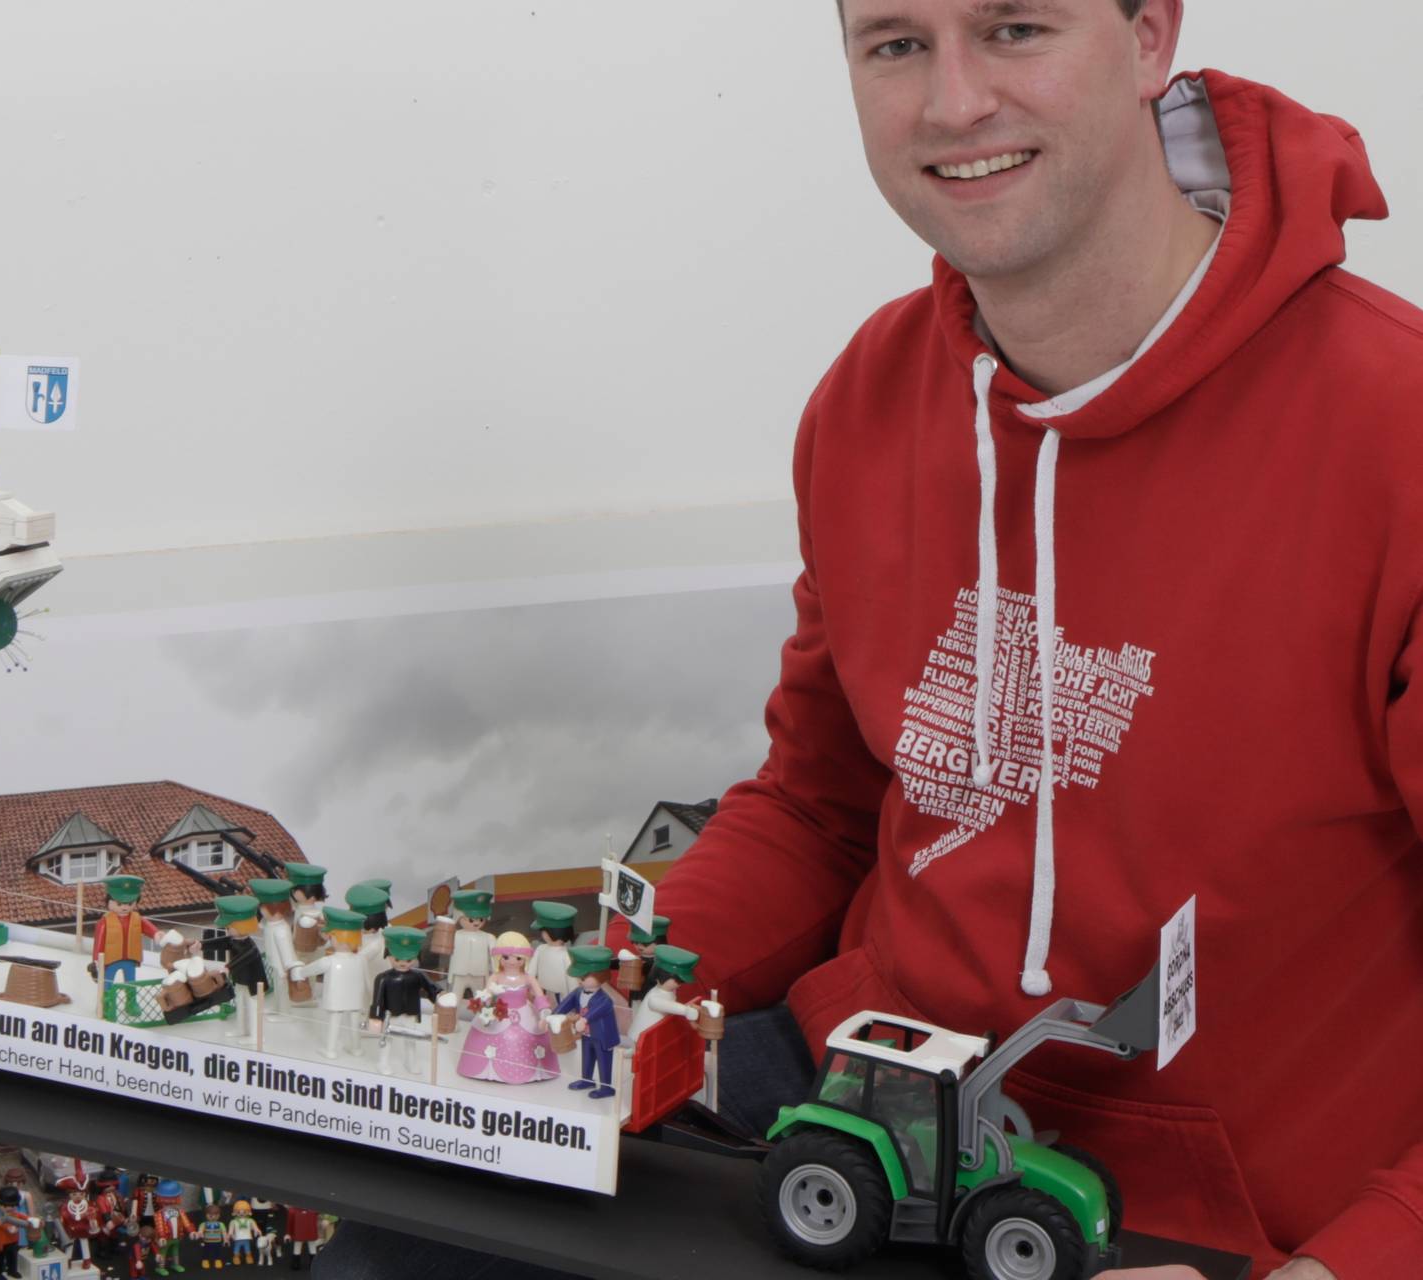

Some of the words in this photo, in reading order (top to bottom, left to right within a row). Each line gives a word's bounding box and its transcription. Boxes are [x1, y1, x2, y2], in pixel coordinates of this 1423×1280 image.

[1120, 642, 1156, 667] ACHT
[1097, 679, 1139, 709] ACHT
[1074, 743, 1104, 761] FORST
[1070, 771, 1099, 789] ACHT
[31, 1021, 59, 1046] an
[63, 1024, 104, 1056] den
[109, 1033, 195, 1077] Kragen,
[204, 1052, 241, 1082] die
[246, 1059, 327, 1099] Flinten
[331, 1078, 383, 1111] sind
[389, 1090, 476, 1130] bereits
[481, 1109, 592, 1152] geladen.
[58, 1056, 111, 1087] Hand,
[115, 1069, 194, 1102] beenden
[203, 1091, 229, 1109] wir
[234, 1094, 263, 1116] die
[267, 1101, 363, 1136] Pandemie
[368, 1122, 391, 1142] im
[397, 1126, 502, 1165] Sauerland!
